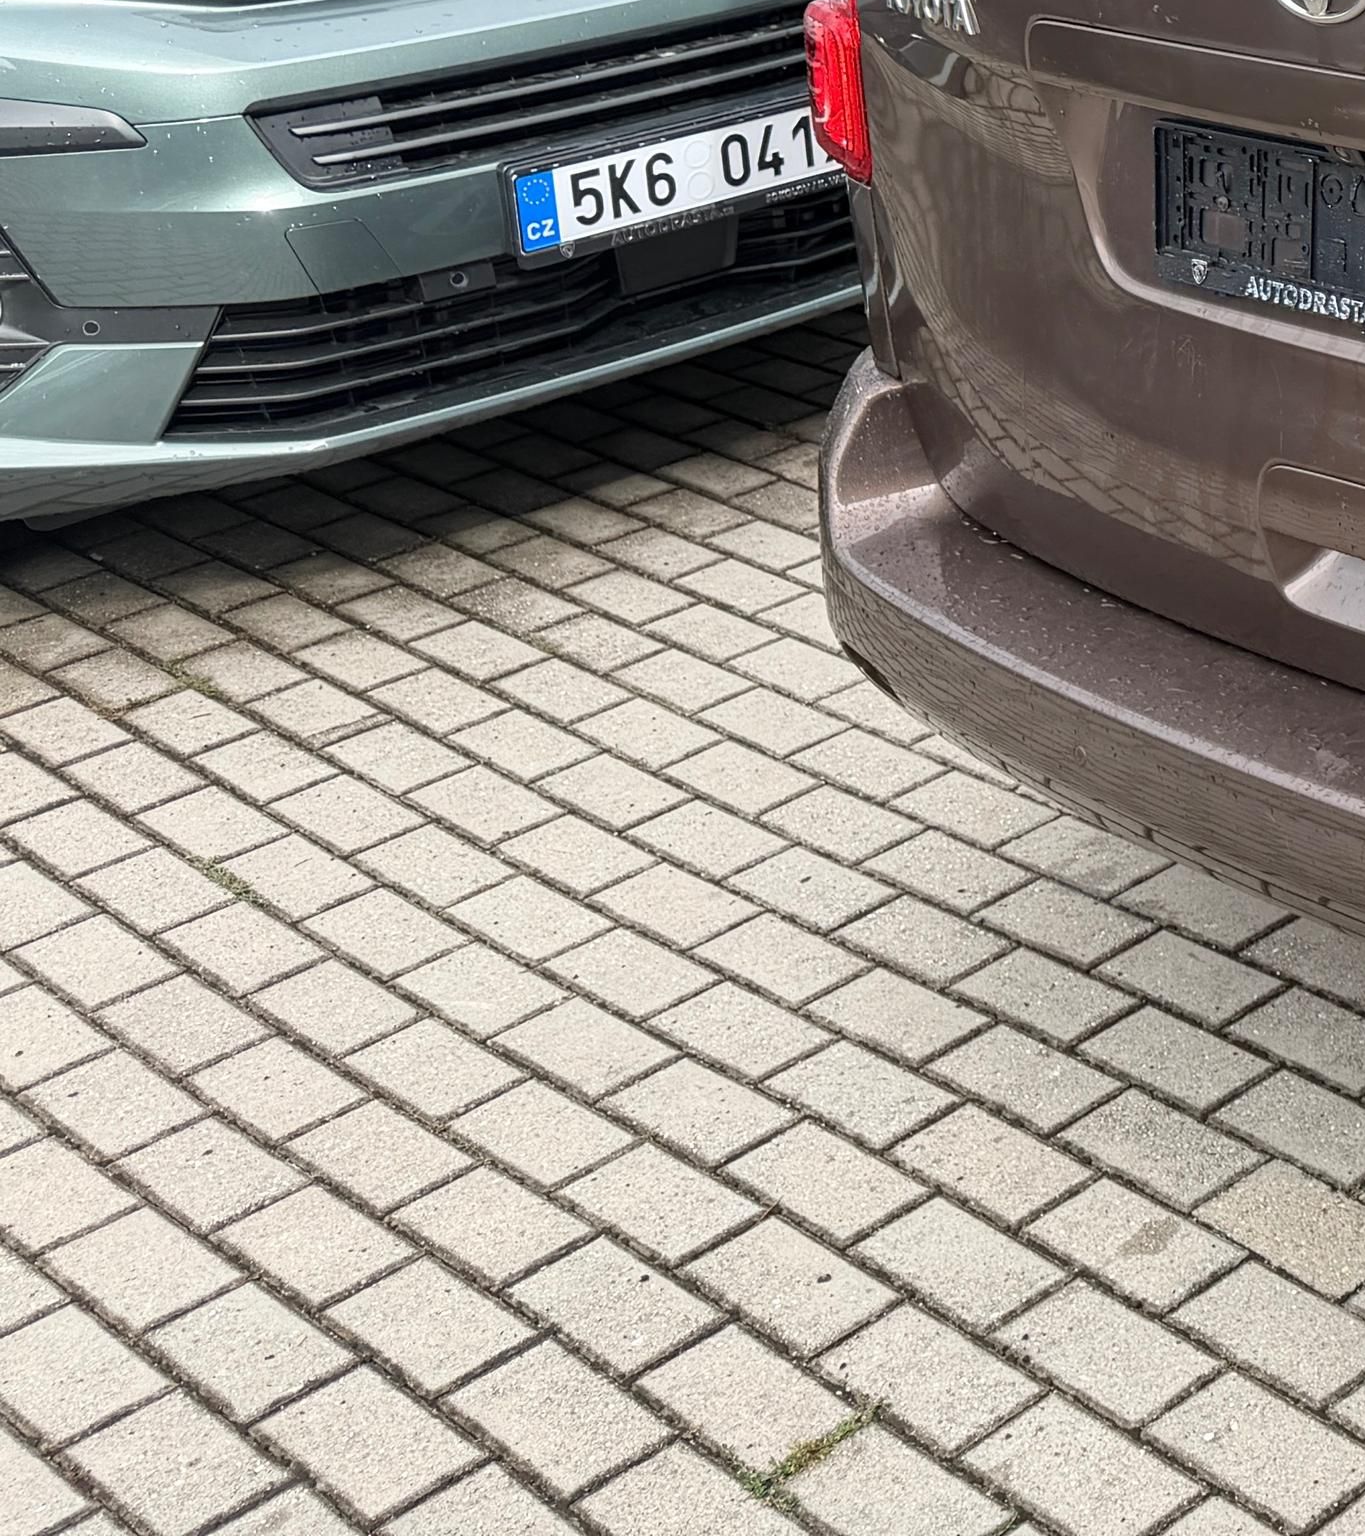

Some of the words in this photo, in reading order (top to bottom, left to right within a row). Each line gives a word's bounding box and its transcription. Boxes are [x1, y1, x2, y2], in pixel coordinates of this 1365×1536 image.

[570, 152, 677, 227] 5K6
[720, 115, 836, 187] 041
[527, 217, 556, 242] CZ
